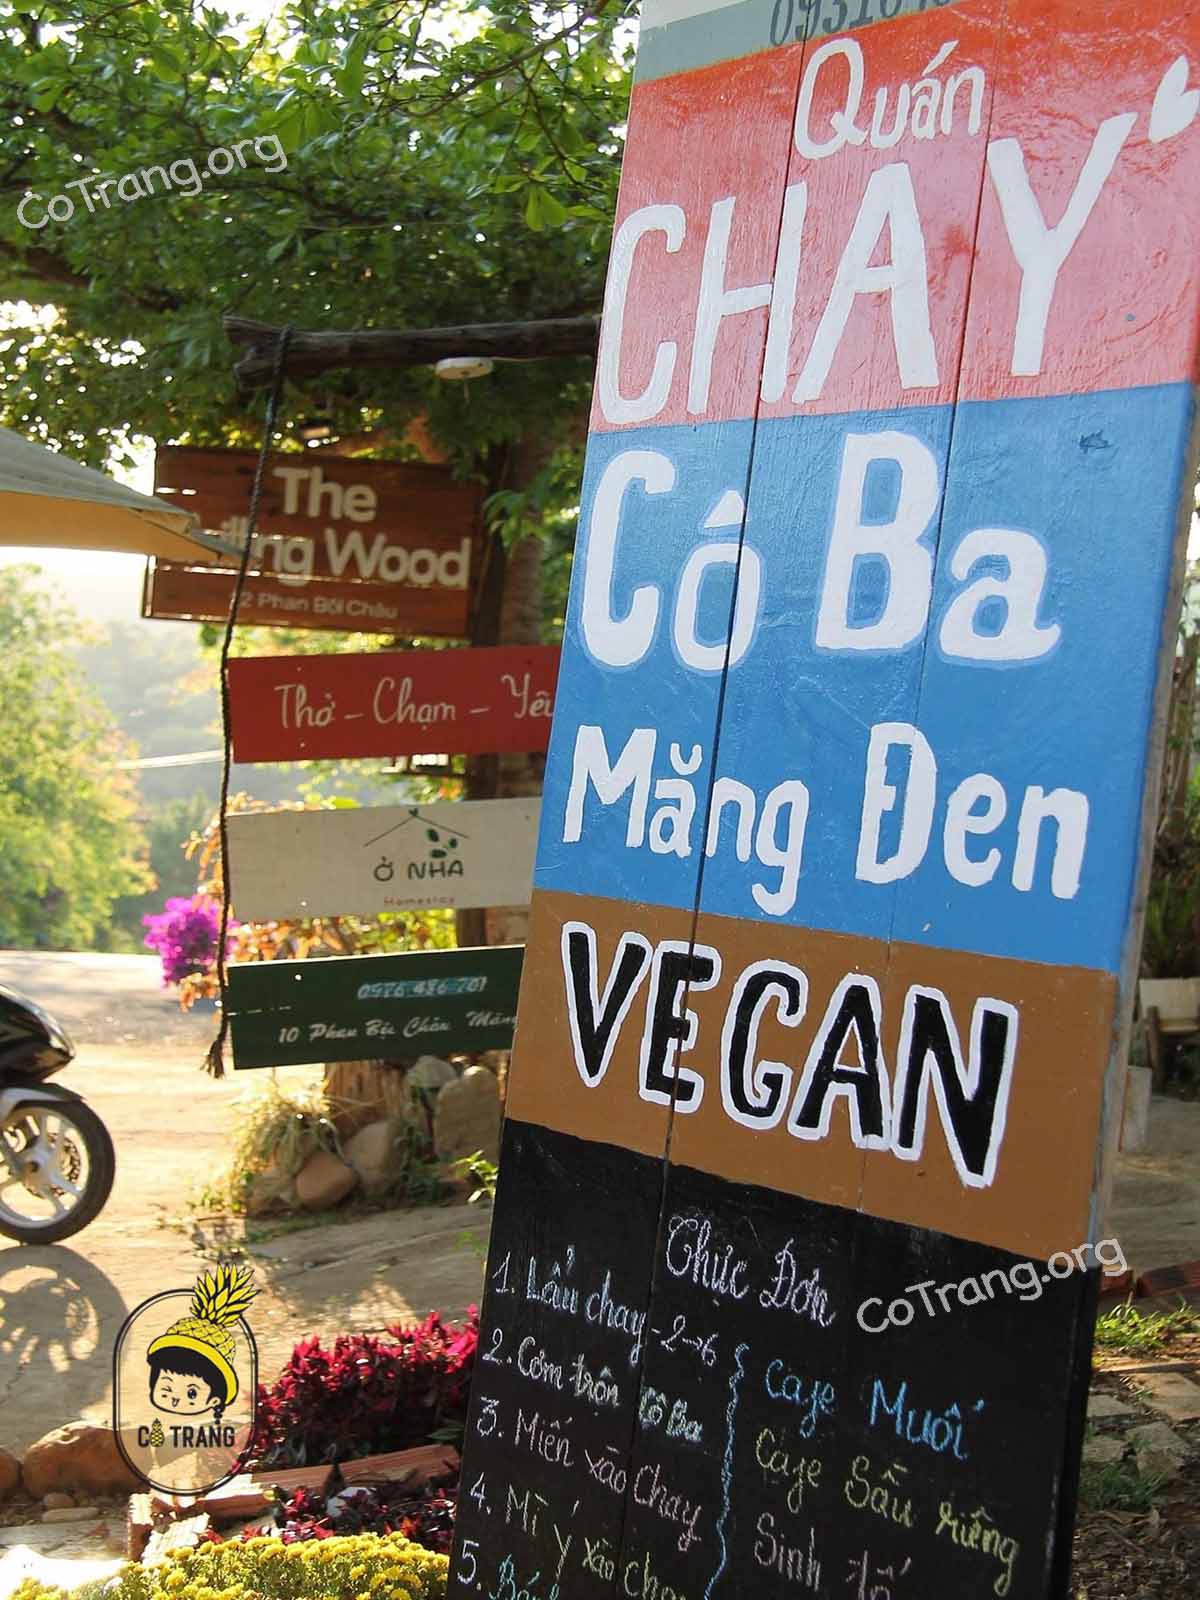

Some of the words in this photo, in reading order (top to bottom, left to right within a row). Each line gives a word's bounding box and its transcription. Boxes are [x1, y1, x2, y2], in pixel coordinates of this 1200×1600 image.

[796, 38, 986, 160] Quán
[598, 112, 1138, 424] CHAY
[274, 467, 377, 522] The
[325, 529, 471, 590] Wood
[816, 431, 1061, 661] Ba
[373, 676, 457, 731] Chạm
[563, 725, 809, 916] Măng
[856, 722, 1089, 899] Đen
[279, 1026, 299, 1043] 10
[561, 921, 1018, 1188] VEGAN
[492, 1251, 516, 1294] 1.
[482, 1328, 512, 1365] 2.
[477, 1397, 504, 1437] 3.
[470, 1472, 491, 1515] 4.
[457, 1540, 482, 1591] 5.
[754, 1512, 821, 1591] Sinh
